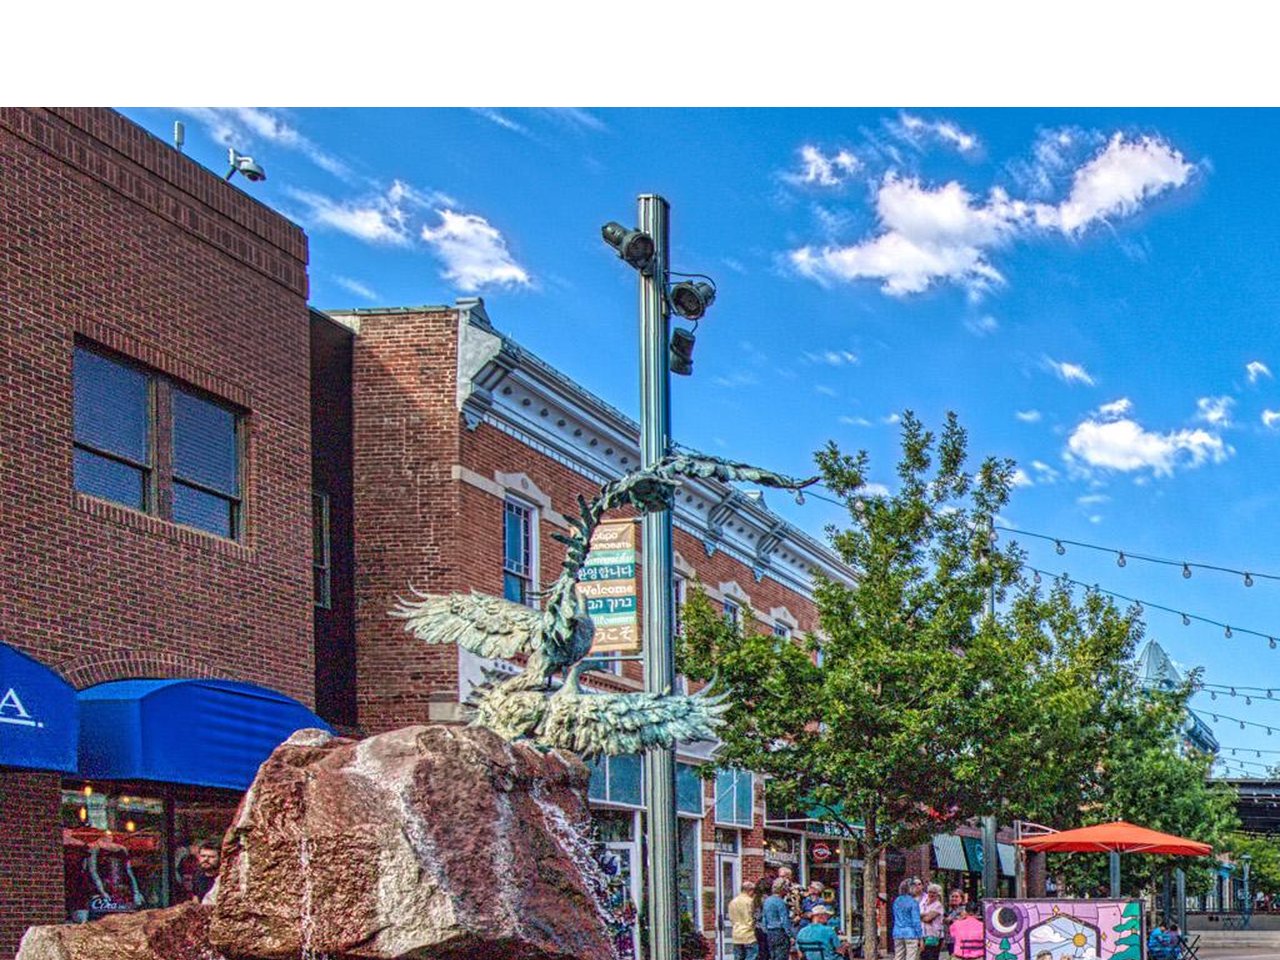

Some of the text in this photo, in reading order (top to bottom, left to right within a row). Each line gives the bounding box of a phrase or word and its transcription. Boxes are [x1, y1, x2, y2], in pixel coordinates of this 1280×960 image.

[578, 582, 634, 595] Welcome
[588, 599, 603, 609] הב
[595, 626, 634, 641] うこそ
